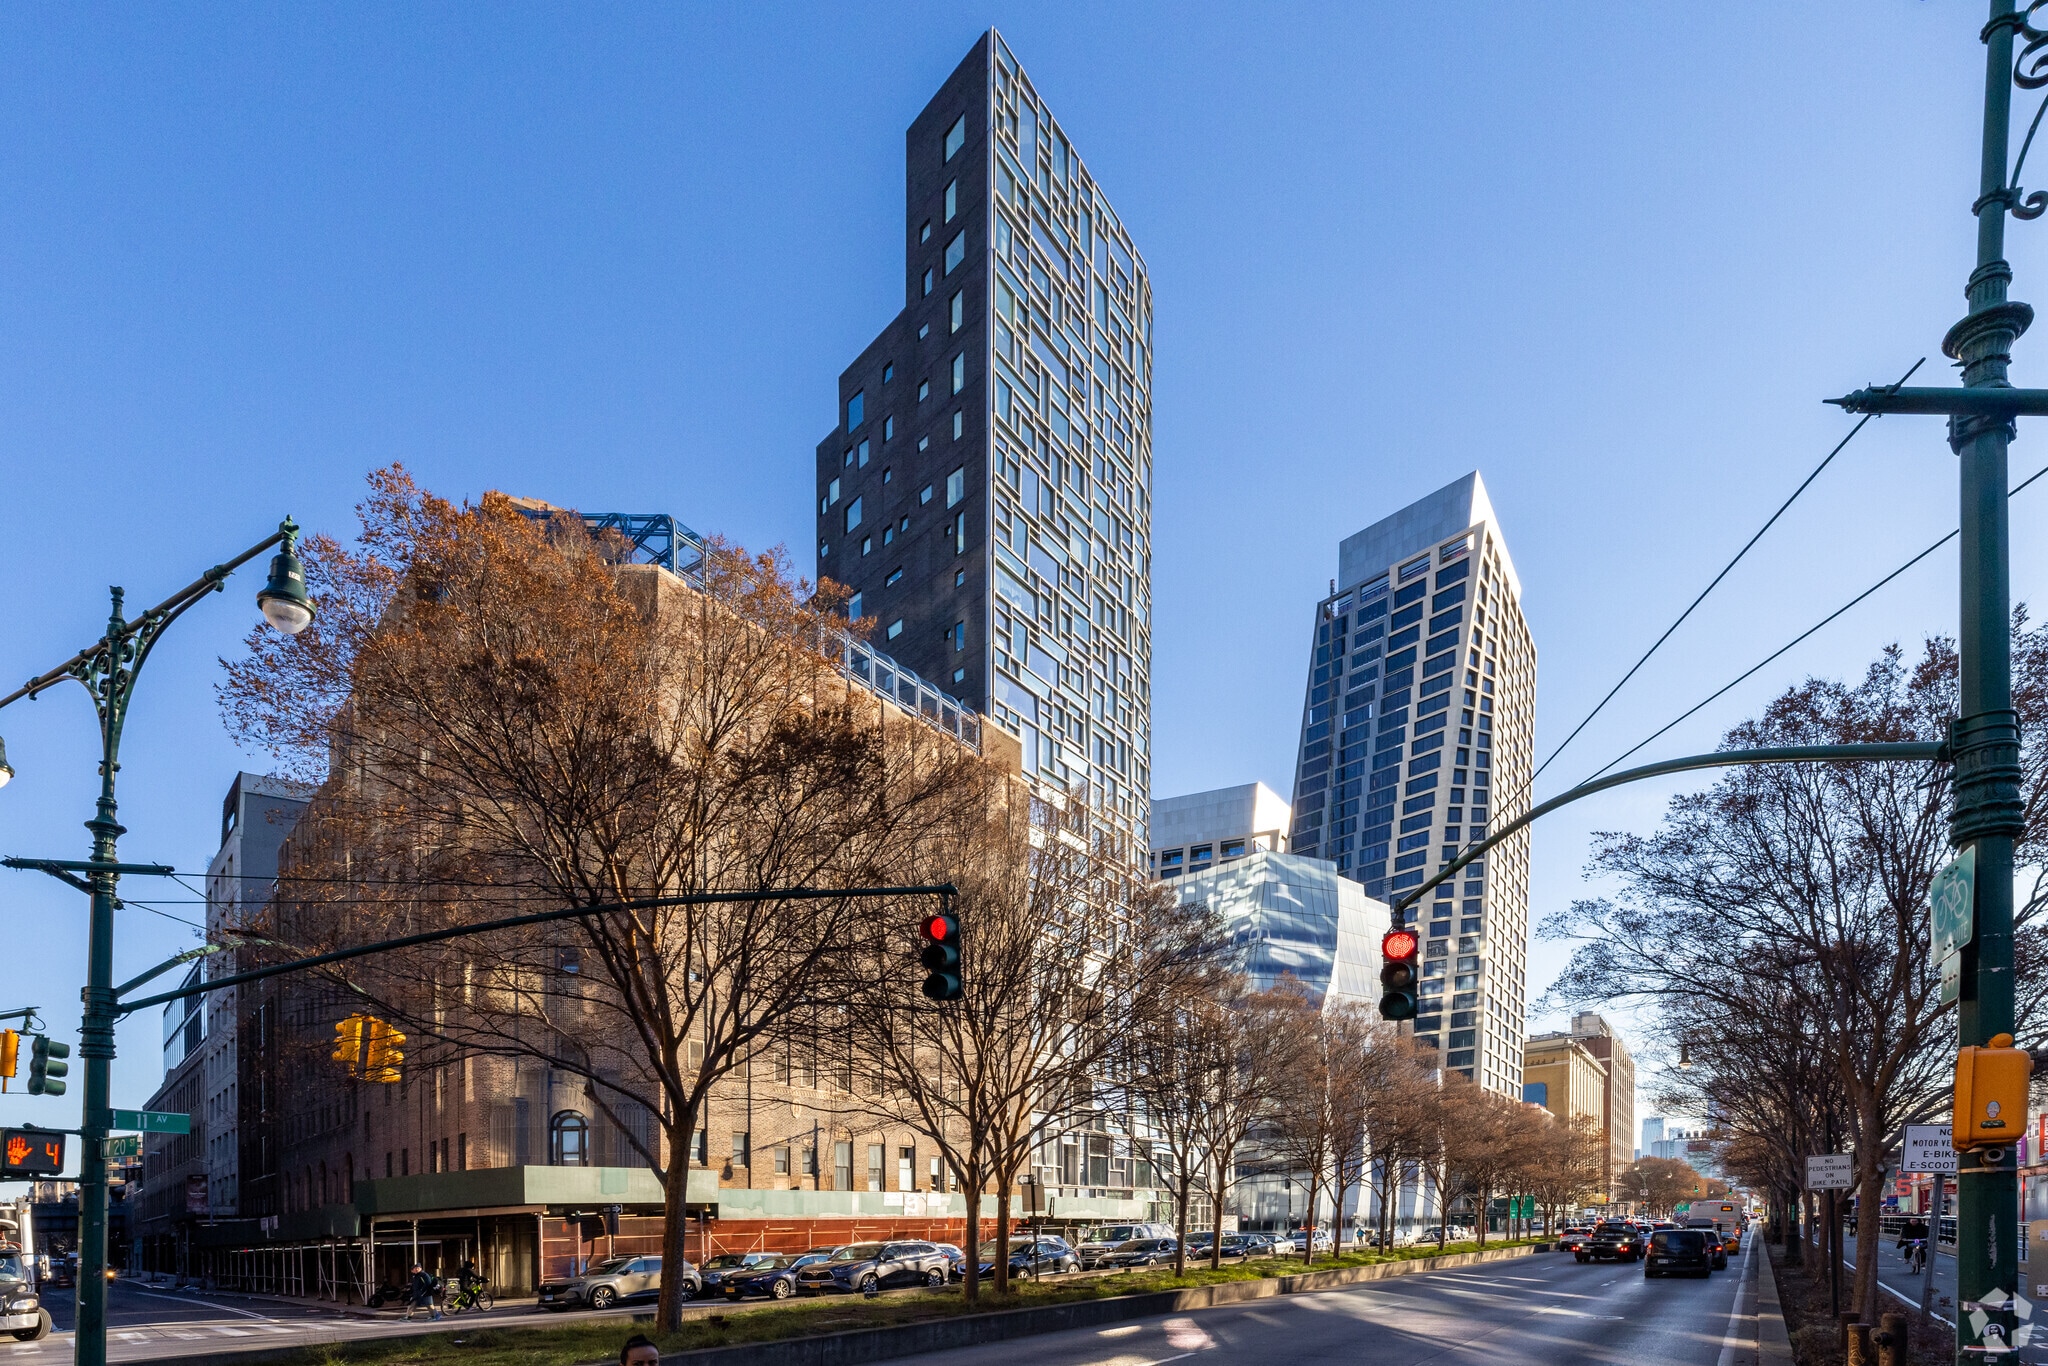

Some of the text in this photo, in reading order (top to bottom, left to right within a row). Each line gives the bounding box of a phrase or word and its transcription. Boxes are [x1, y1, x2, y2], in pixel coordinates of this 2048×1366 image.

[136, 1113, 168, 1129] 11 AV
[1912, 1139, 1951, 1147] MOTOR VE
[103, 1140, 111, 1156] W
[114, 1139, 126, 1155] 20
[45, 1142, 59, 1167] 4
[1923, 1150, 1957, 1158] E-BIKE
[1808, 1164, 1851, 1172] PEDESTRIANS
[1910, 1161, 1956, 1169] E-SCOOT
